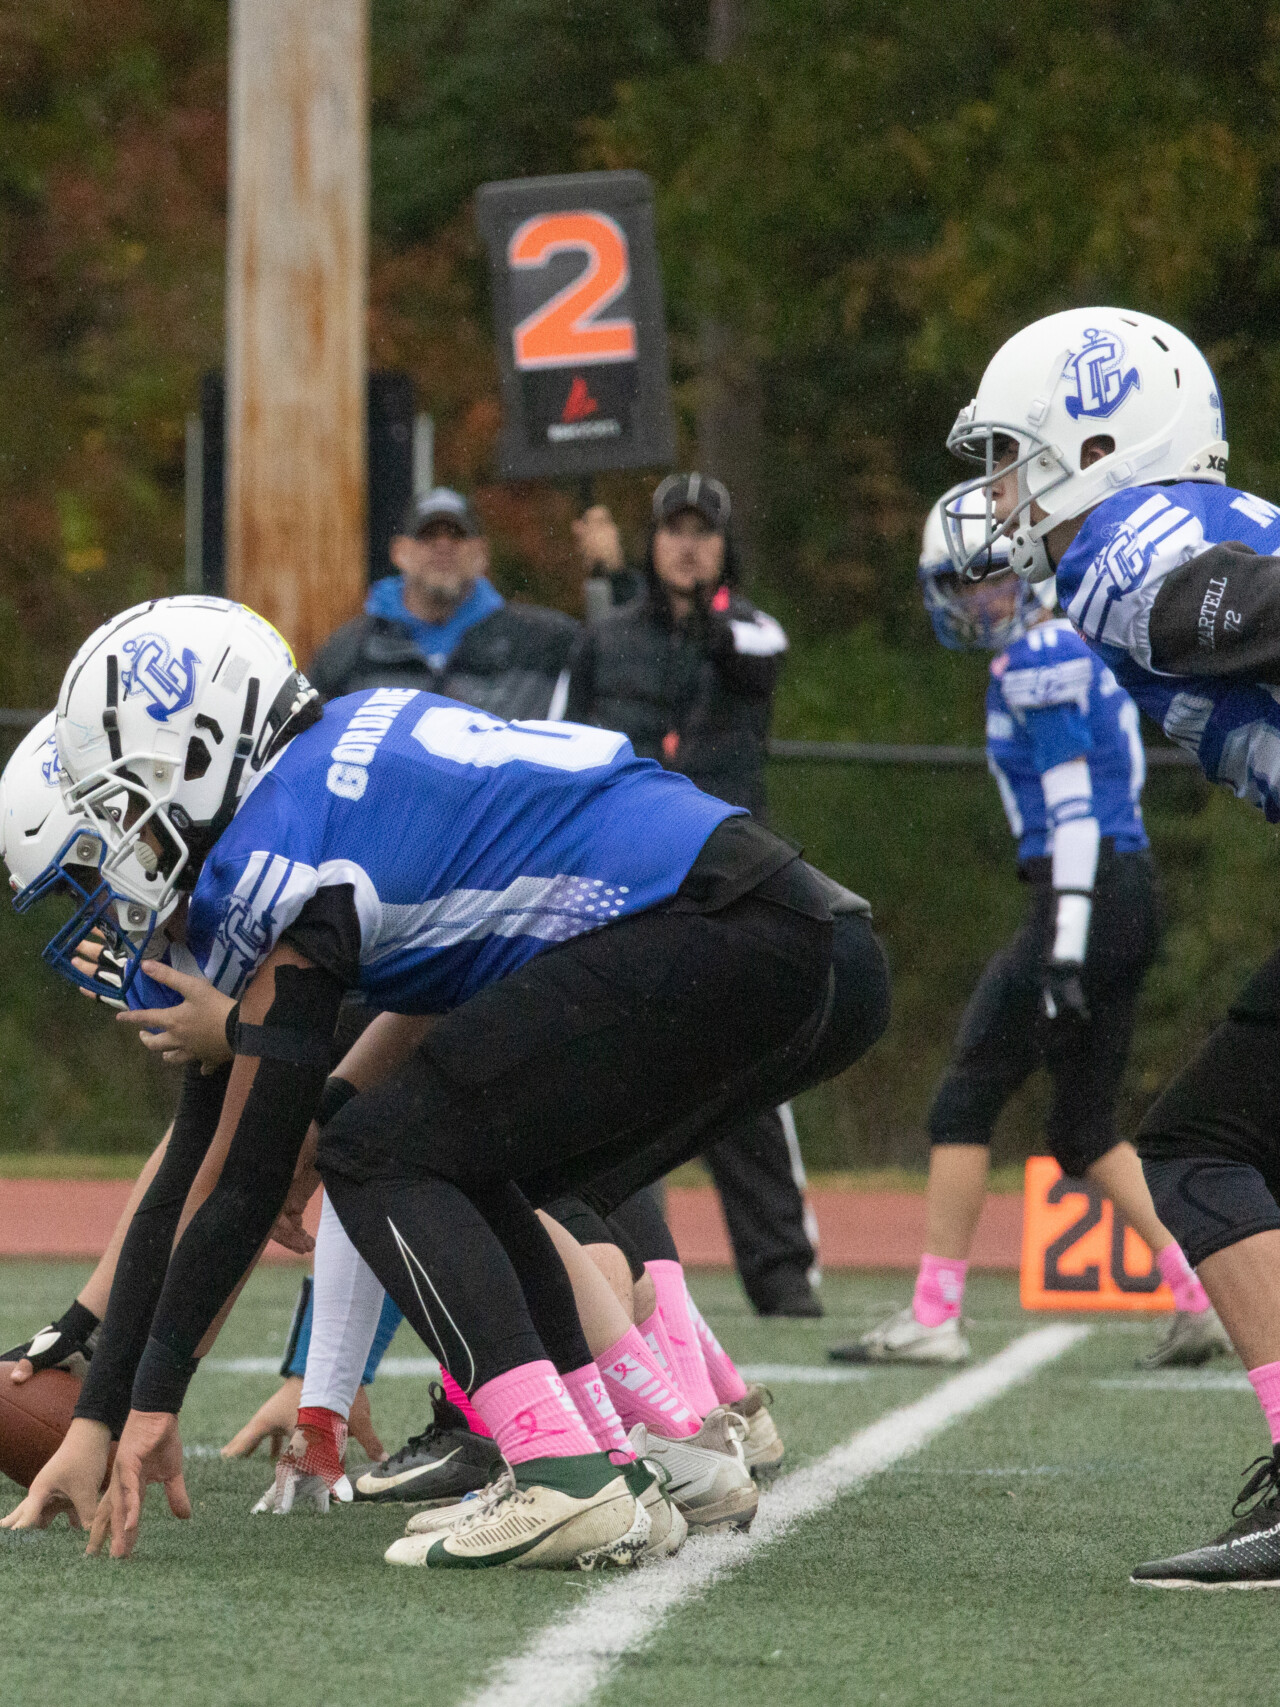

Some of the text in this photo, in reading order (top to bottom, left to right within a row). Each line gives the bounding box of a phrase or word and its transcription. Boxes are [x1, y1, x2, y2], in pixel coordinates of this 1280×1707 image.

[508, 209, 638, 370] 2
[1223, 609, 1242, 633] 72
[1043, 1178, 1163, 1294] 20
